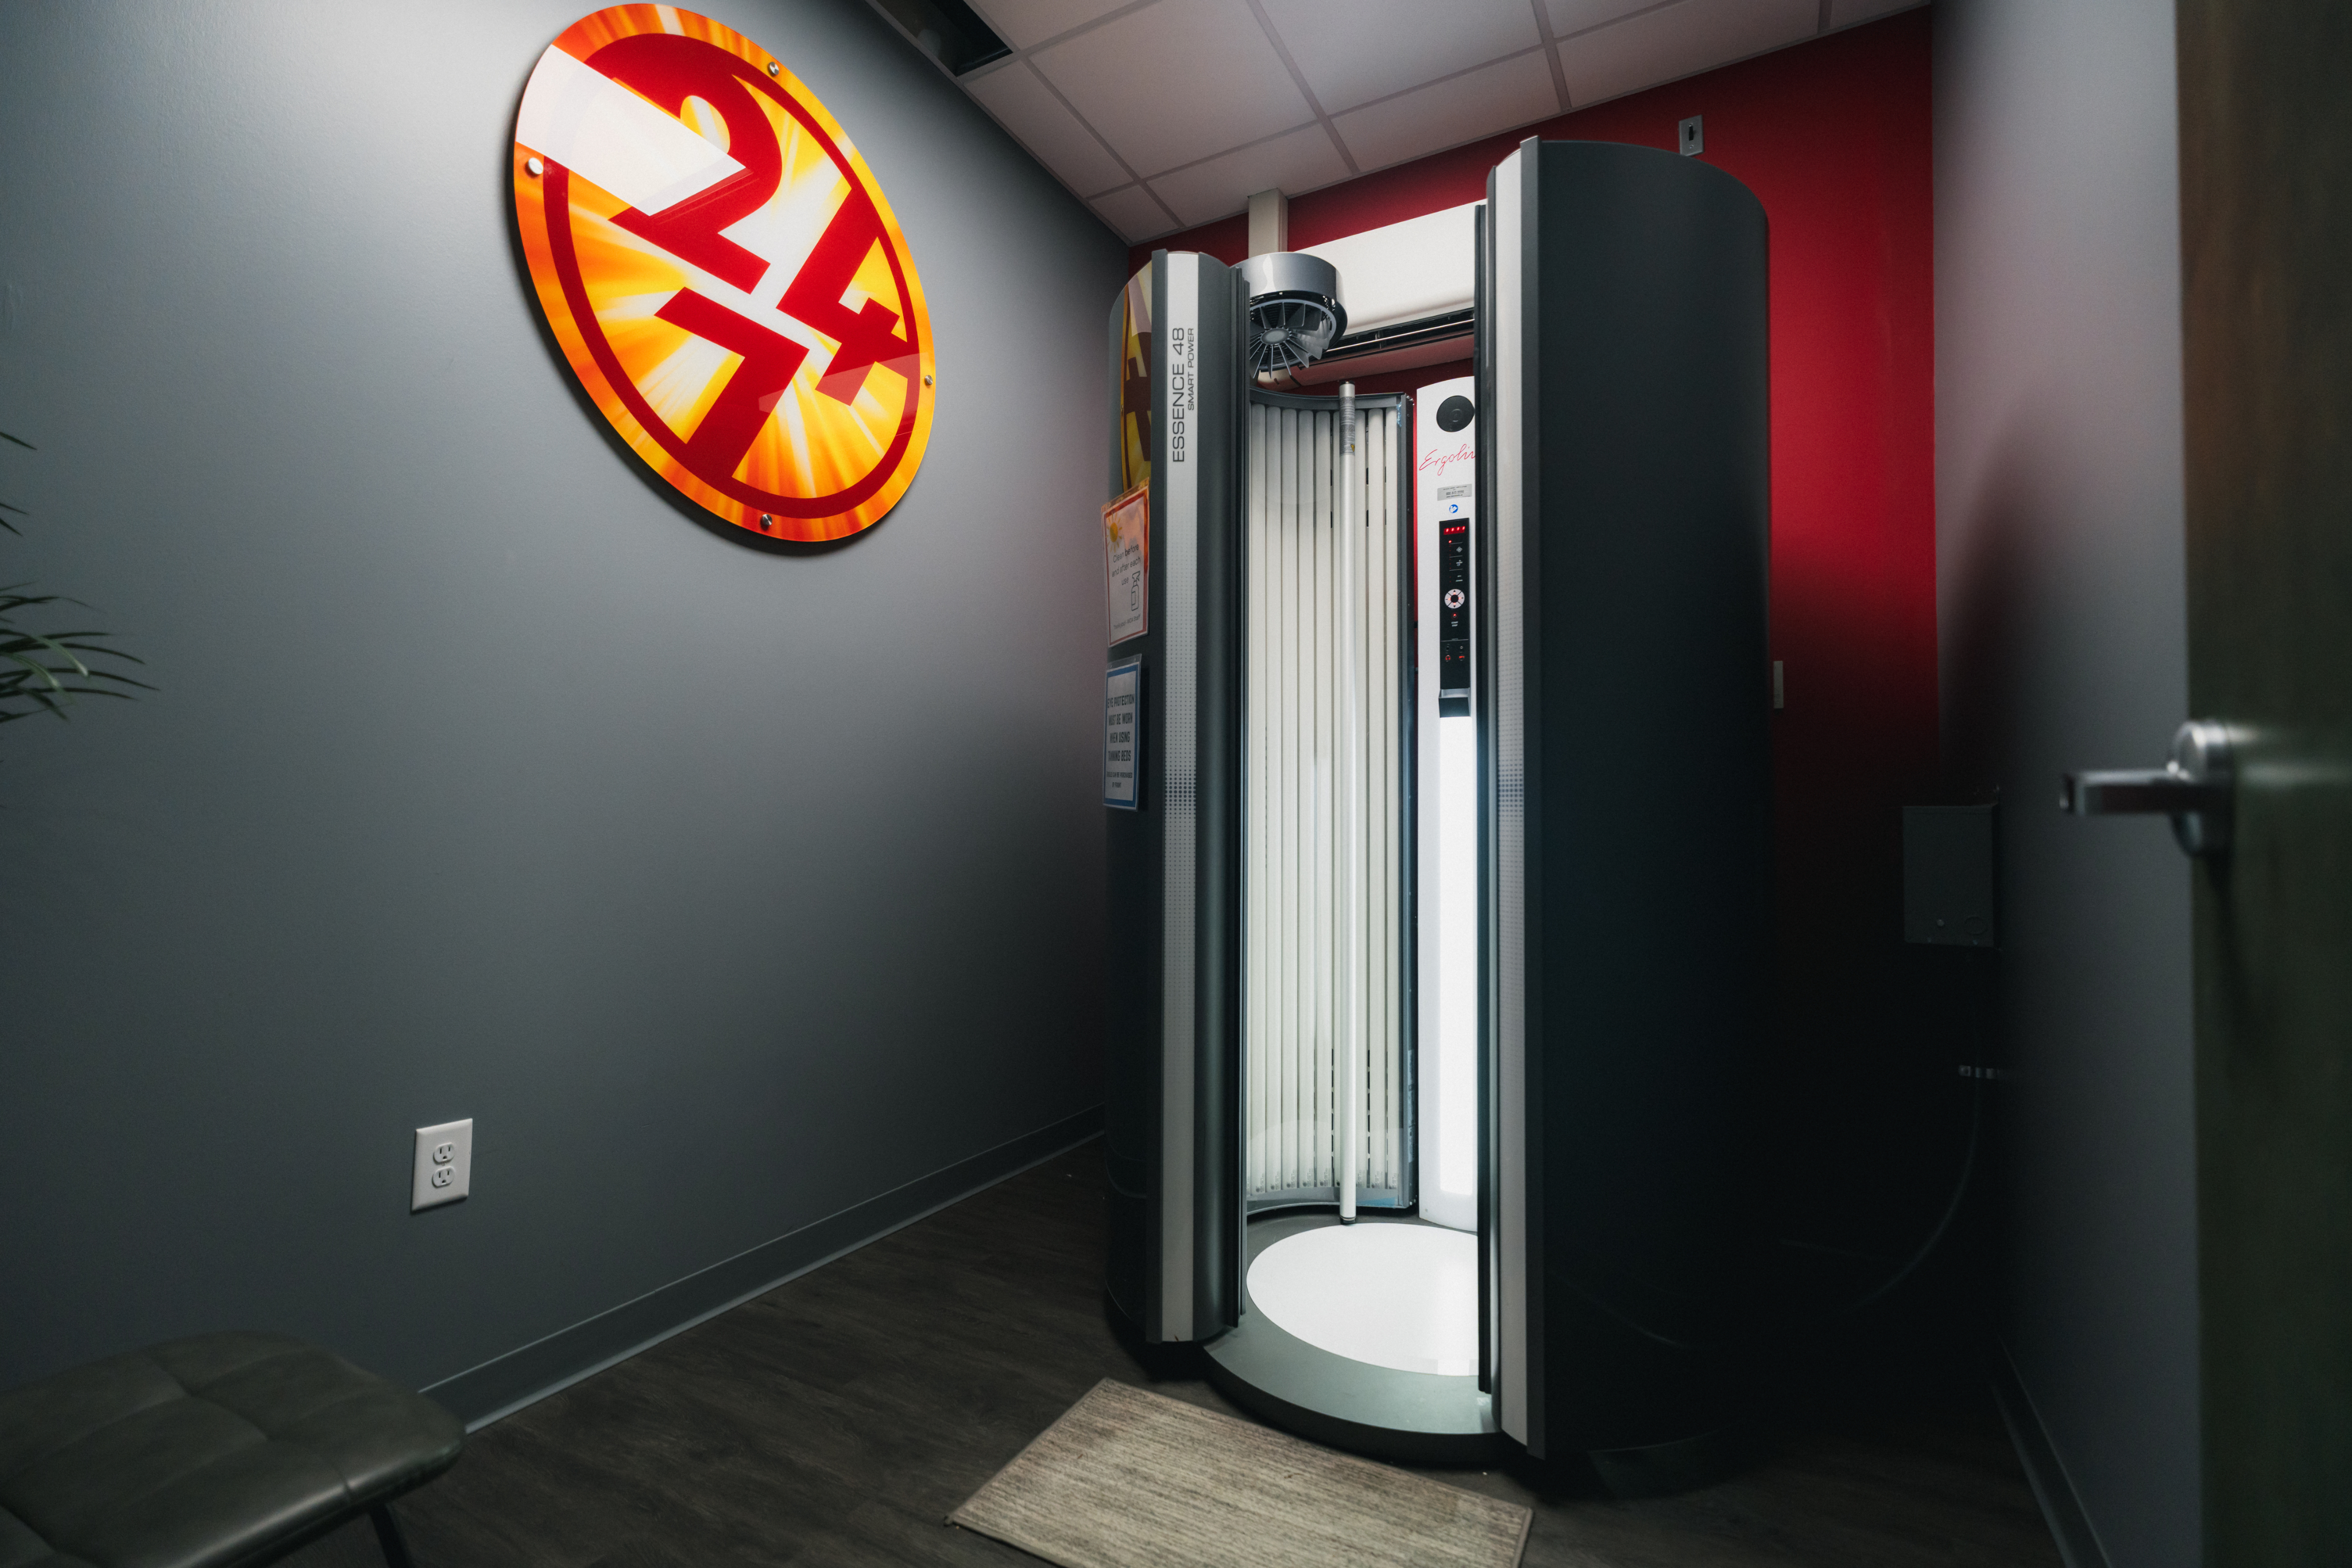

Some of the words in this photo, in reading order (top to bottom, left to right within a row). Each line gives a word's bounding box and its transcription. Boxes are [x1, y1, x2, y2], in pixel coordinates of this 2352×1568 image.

[1172, 327, 1185, 355] 48
[1172, 363, 1185, 462] ESSENCE
[1113, 551, 1124, 563] Clean
[1124, 544, 1139, 557] before
[1120, 562, 1129, 573] after
[1129, 556, 1141, 568] each
[1114, 694, 1135, 707] PROTECTION
[1108, 714, 1116, 726] MUST
[1116, 713, 1121, 725] BE
[1122, 712, 1133, 724] WORN
[1109, 732, 1118, 744] WHEN
[1119, 731, 1130, 743] USING
[1108, 750, 1120, 761] TANNING
[1121, 750, 1131, 761] BEDS
